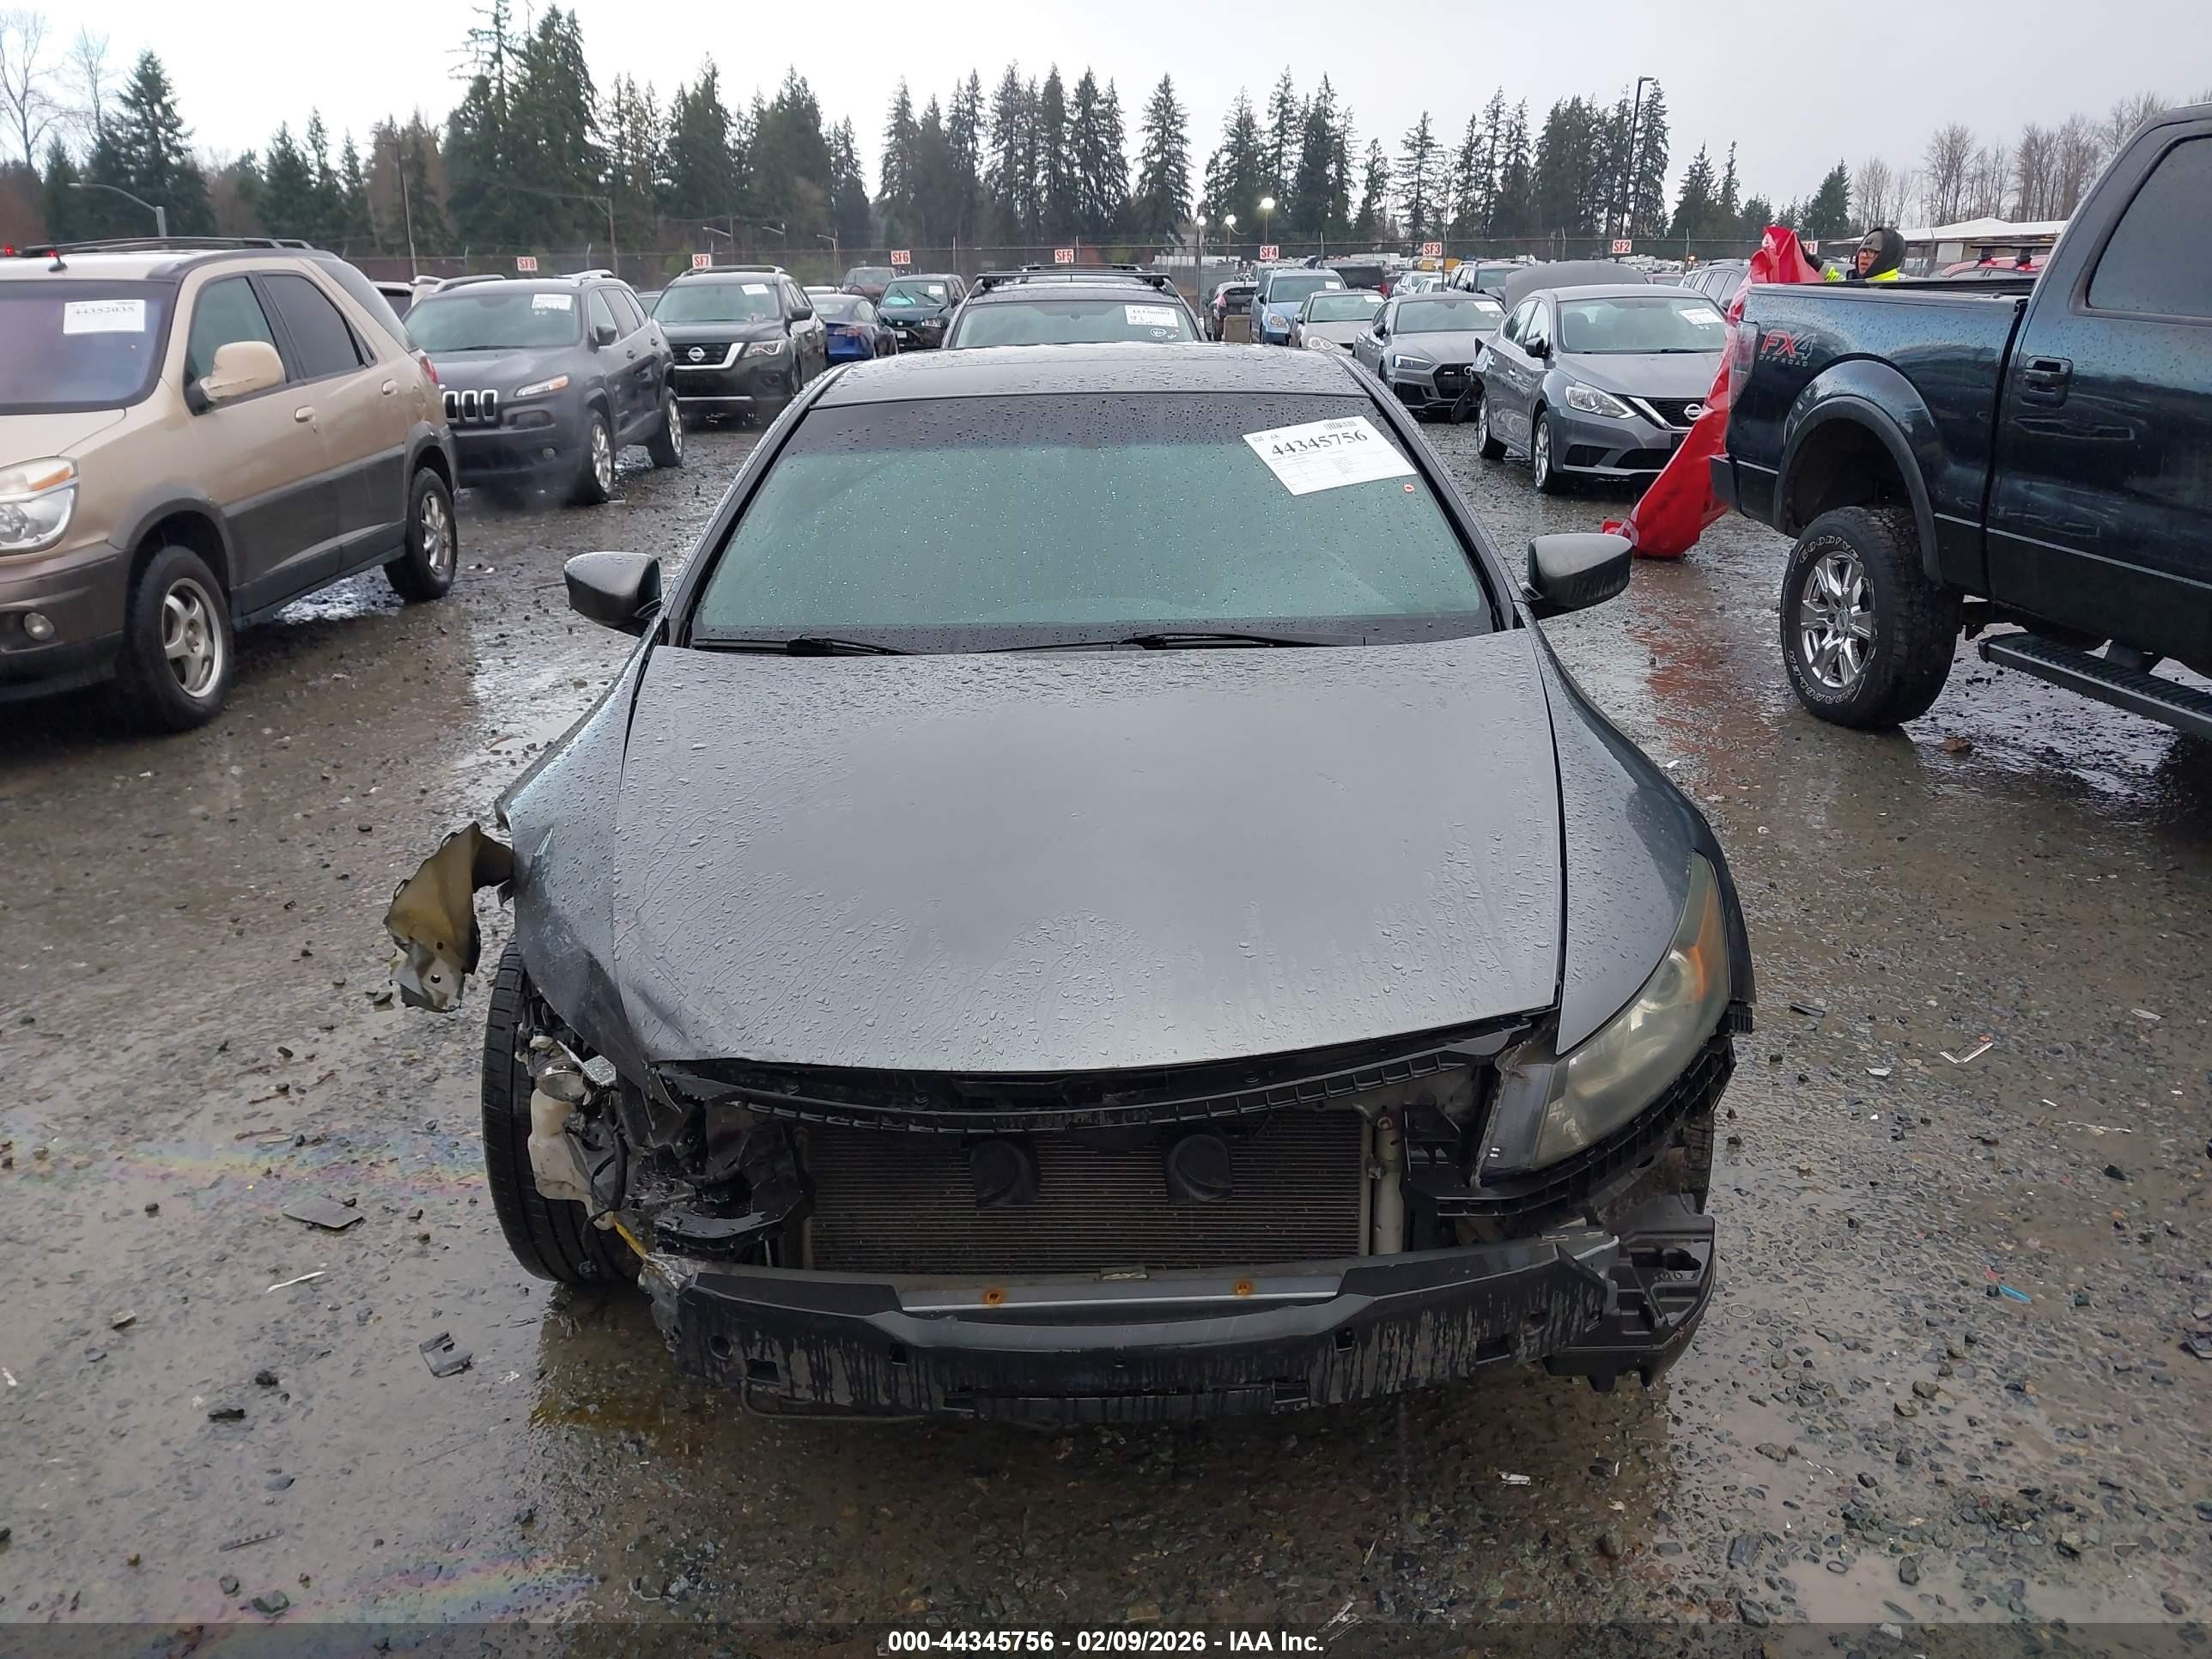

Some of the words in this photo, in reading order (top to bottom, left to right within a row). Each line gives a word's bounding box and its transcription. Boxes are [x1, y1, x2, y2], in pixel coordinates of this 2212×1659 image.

[1261, 246, 1277, 258] SF4
[1424, 244, 1441, 255] SF3
[1613, 241, 1630, 252] SF2
[694, 256, 709, 267] SF7
[892, 252, 909, 263] SF6
[1056, 250, 1073, 262] SF5
[519, 258, 536, 269] SF8
[1759, 329, 1816, 361] FX4
[1780, 357, 1808, 367] ROAD
[1272, 429, 1368, 456] 44345756
